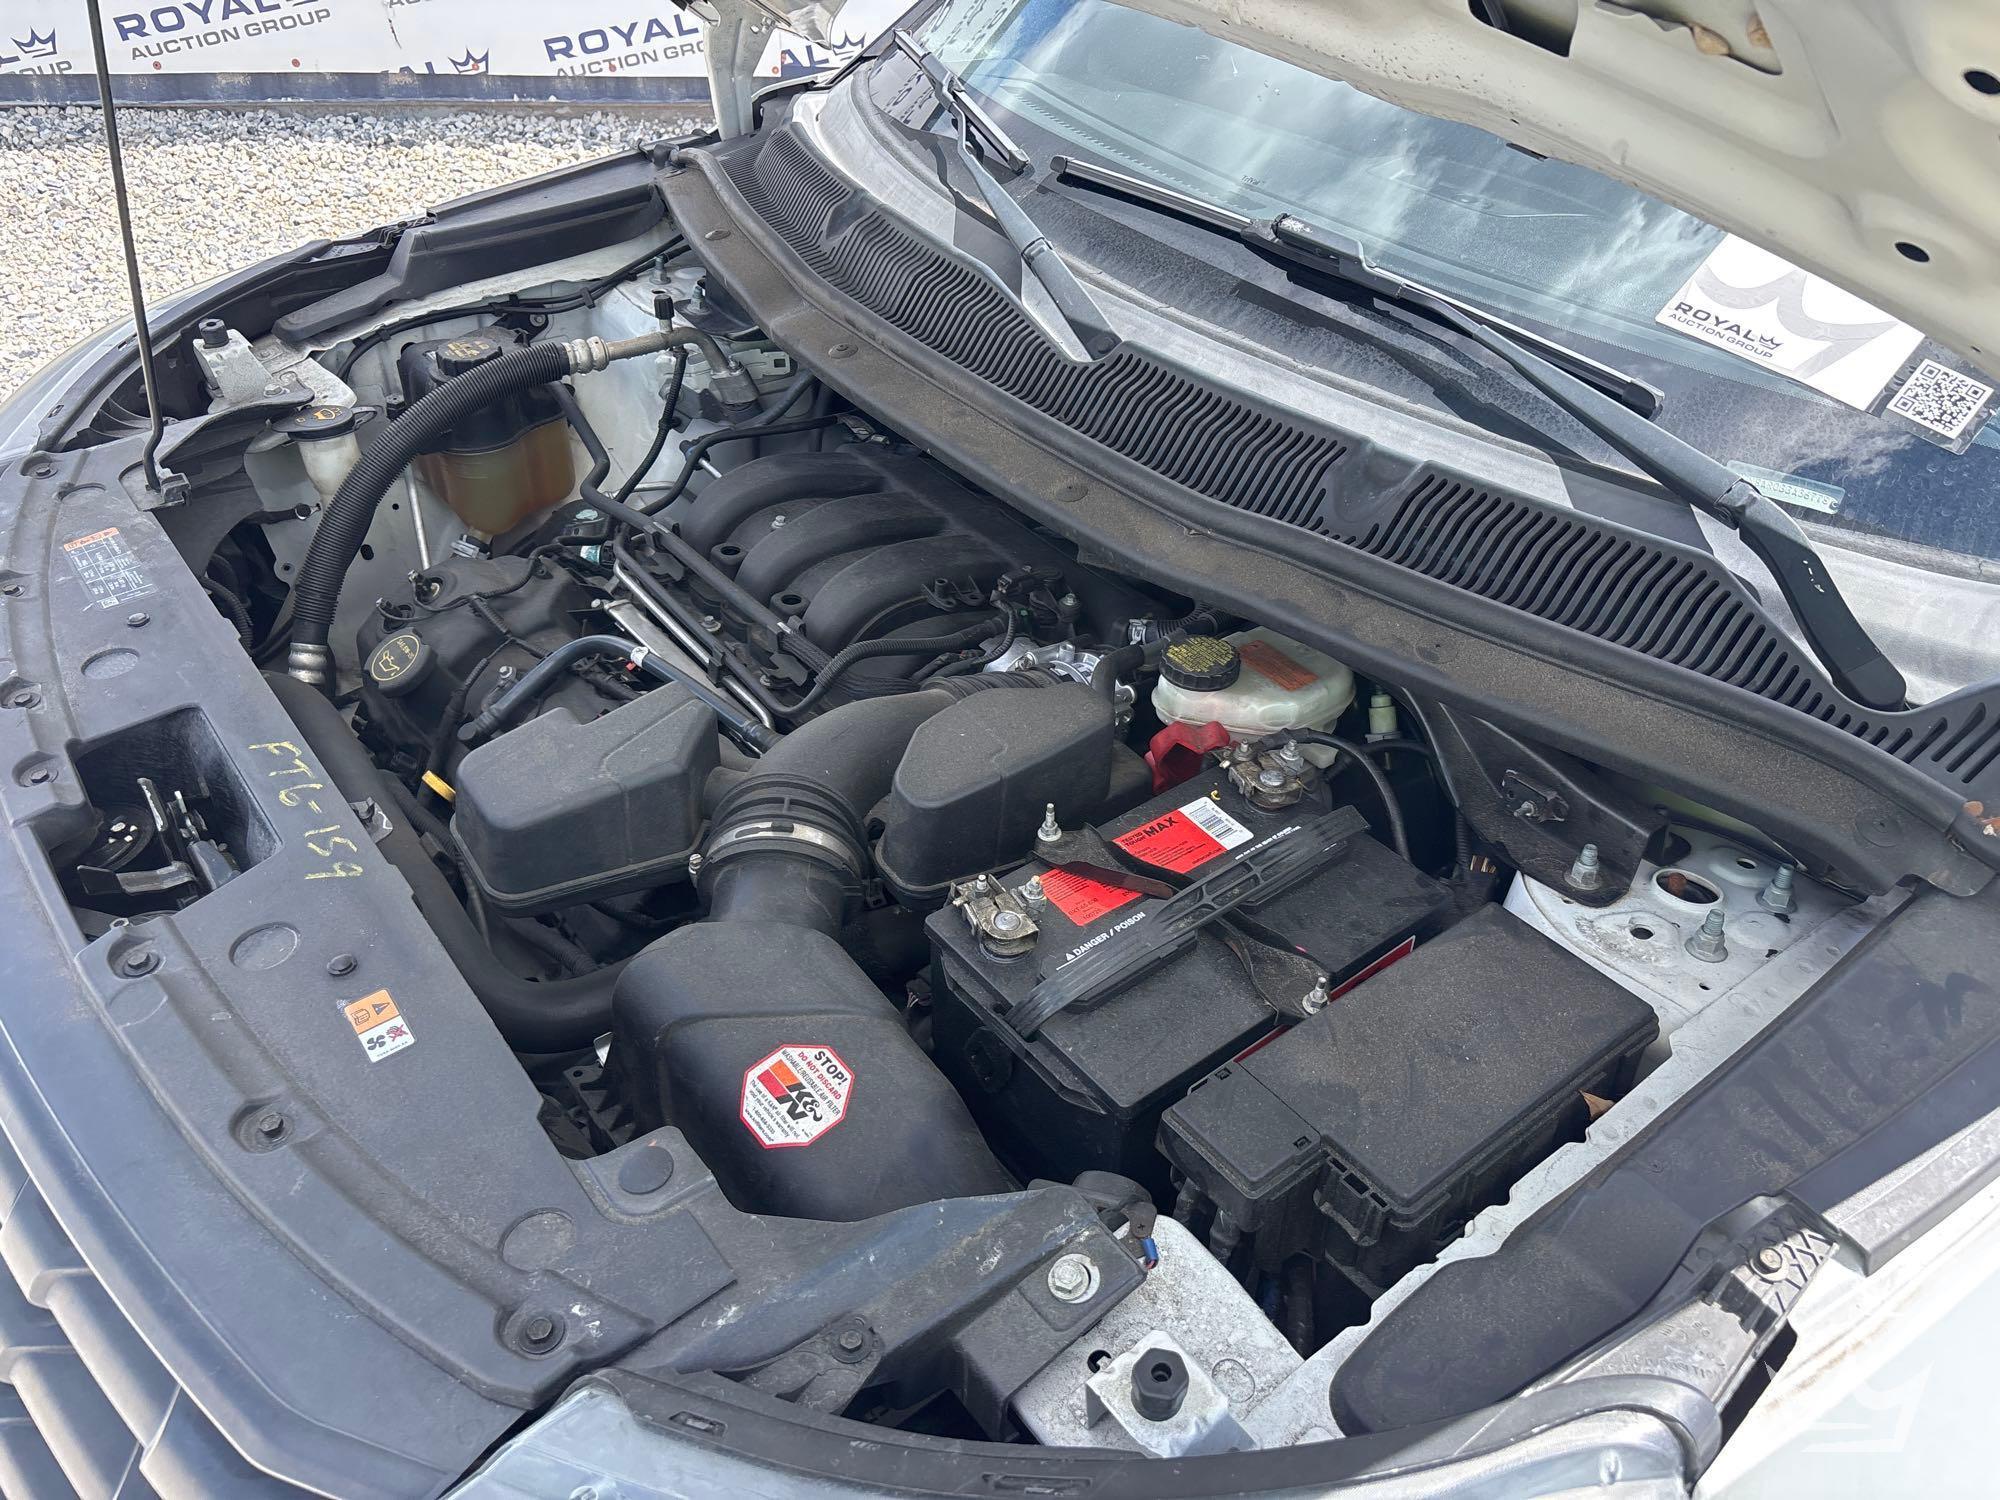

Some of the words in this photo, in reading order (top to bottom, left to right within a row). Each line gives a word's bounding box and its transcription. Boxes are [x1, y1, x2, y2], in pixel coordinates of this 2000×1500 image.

[131, 26, 240, 60] AUCTION
[244, 8, 331, 37] GROUP
[543, 13, 700, 62] ROYAL
[556, 48, 659, 77] AUCTION
[1667, 313, 1726, 340] AUCTION
[1726, 335, 1774, 359] GROUP
[1674, 301, 1756, 342] ROYAL
[1142, 816, 1179, 838] MAX
[1072, 932, 1110, 956] DANGER
[1109, 928, 1114, 937] /
[1113, 911, 1146, 933] POISON
[797, 1051, 809, 1062] DO
[805, 1060, 820, 1075] NOT
[816, 1073, 842, 1100] DISCARD
[814, 1050, 848, 1086] STOP!
[819, 1092, 829, 1102] AIR
[825, 1099, 841, 1116] FILTER
